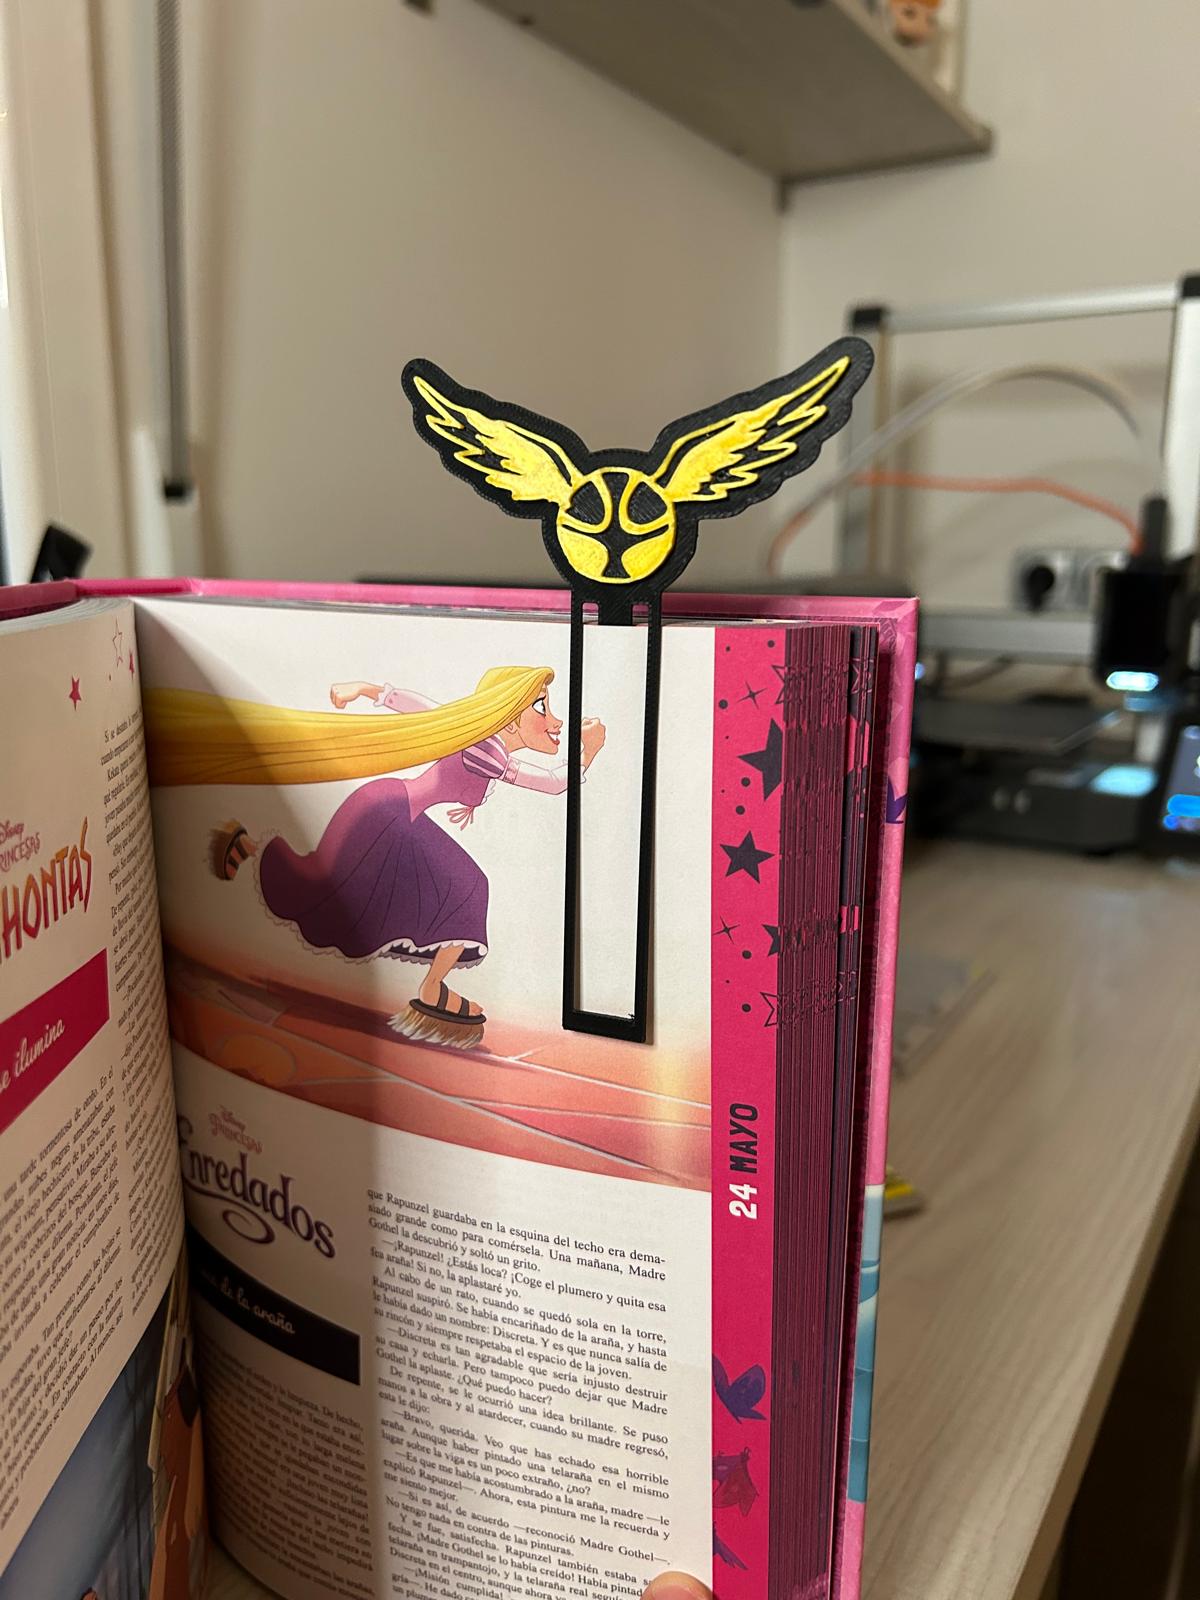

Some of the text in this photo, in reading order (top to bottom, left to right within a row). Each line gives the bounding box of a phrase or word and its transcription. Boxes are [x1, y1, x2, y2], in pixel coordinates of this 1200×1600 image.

[0, 832, 41, 873] RINCESAS
[0, 816, 92, 964] HONTAS
[14, 1019, 66, 1078] ilumina
[728, 1102, 759, 1220] 24 MAYO
[460, 1247, 541, 1272] y soltó un grito.
[462, 1233, 666, 1281] para comérsela. Una mañana, Madre
[480, 1222, 666, 1264] en la esquina del techo era dema-
[480, 1264, 666, 1312] loca? ¡Coge el plumero y quita esa
[505, 1288, 521, 1298] yo.
[253, 1304, 297, 1336] araña
[482, 1297, 667, 1344] cuando se quedó sola en la torre,
[501, 1317, 667, 1357] encariñado de la araña, y hasta
[492, 1326, 538, 1345] Discreta.
[540, 1338, 549, 1348] Y
[566, 1347, 586, 1357] que
[589, 1352, 622, 1363] nunca
[624, 1357, 651, 1368] salía
[653, 1361, 667, 1371] de
[514, 1347, 632, 1380] el espacio de la joven.
[474, 1353, 668, 1401] agradable que sería injusto destruir
[485, 1384, 553, 1406] puedo hacer?
[490, 1369, 668, 1415] tampoco puedo dejar que Madre
[478, 1409, 526, 1429] atardecer,
[529, 1423, 568, 1437] cuando
[587, 1436, 621, 1448] madre
[624, 1444, 668, 1459] regresó,
[518, 1407, 669, 1443] una idea brillante. Se puso
[484, 1452, 670, 1498] pintado una telaraña en el mismo
[495, 1468, 591, 1496] poco extraño, ¿no?
[509, 1445, 669, 1484] que has echado esa horrible
[483, 1479, 553, 1500] acostumbrado
[564, 1495, 574, 1505] la
[576, 1501, 608, 1514] araña,
[610, 1509, 644, 1520] madre
[646, 1515, 670, 1525] —le
[516, 1500, 670, 1542] esta pintura me la recuerda y
[505, 1546, 552, 1564] Rapunzel
[557, 1559, 599, 1574] también
[604, 1571, 637, 1583] estaba
[513, 1526, 670, 1565] —reconoció Madre Gothel—.
[514, 1535, 528, 1546] las
[530, 1541, 574, 1556] pinturas.
[503, 1573, 510, 1581] y
[513, 1572, 523, 1581] la
[526, 1576, 566, 1591] telaraña
[568, 1588, 588, 1597] real
[510, 1559, 537, 1573] había
[539, 1569, 575, 1581] creído!
[577, 1575, 608, 1589] Había
[610, 1585, 644, 1598] pintad
